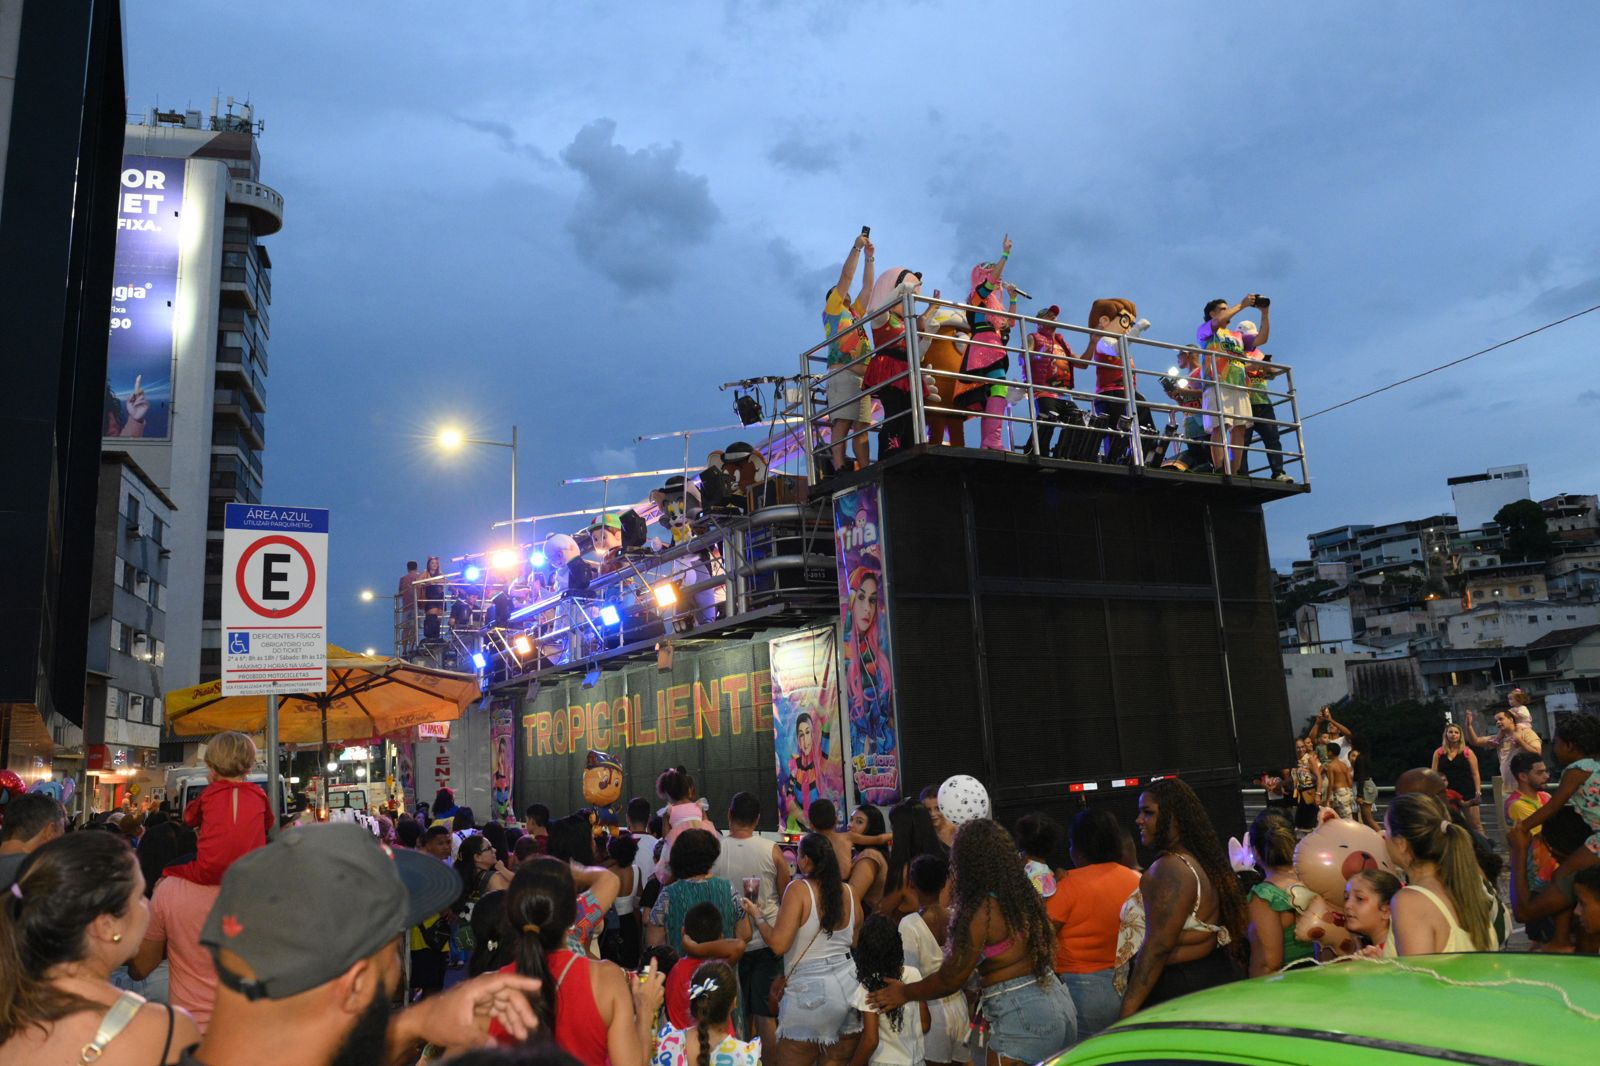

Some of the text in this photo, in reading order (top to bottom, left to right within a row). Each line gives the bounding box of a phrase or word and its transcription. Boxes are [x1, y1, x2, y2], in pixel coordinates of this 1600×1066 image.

[118, 193, 165, 215] ET
[246, 507, 310, 522] ÁREA AZUL
[262, 553, 291, 600] E
[522, 669, 773, 757] TROPICALIENTE
